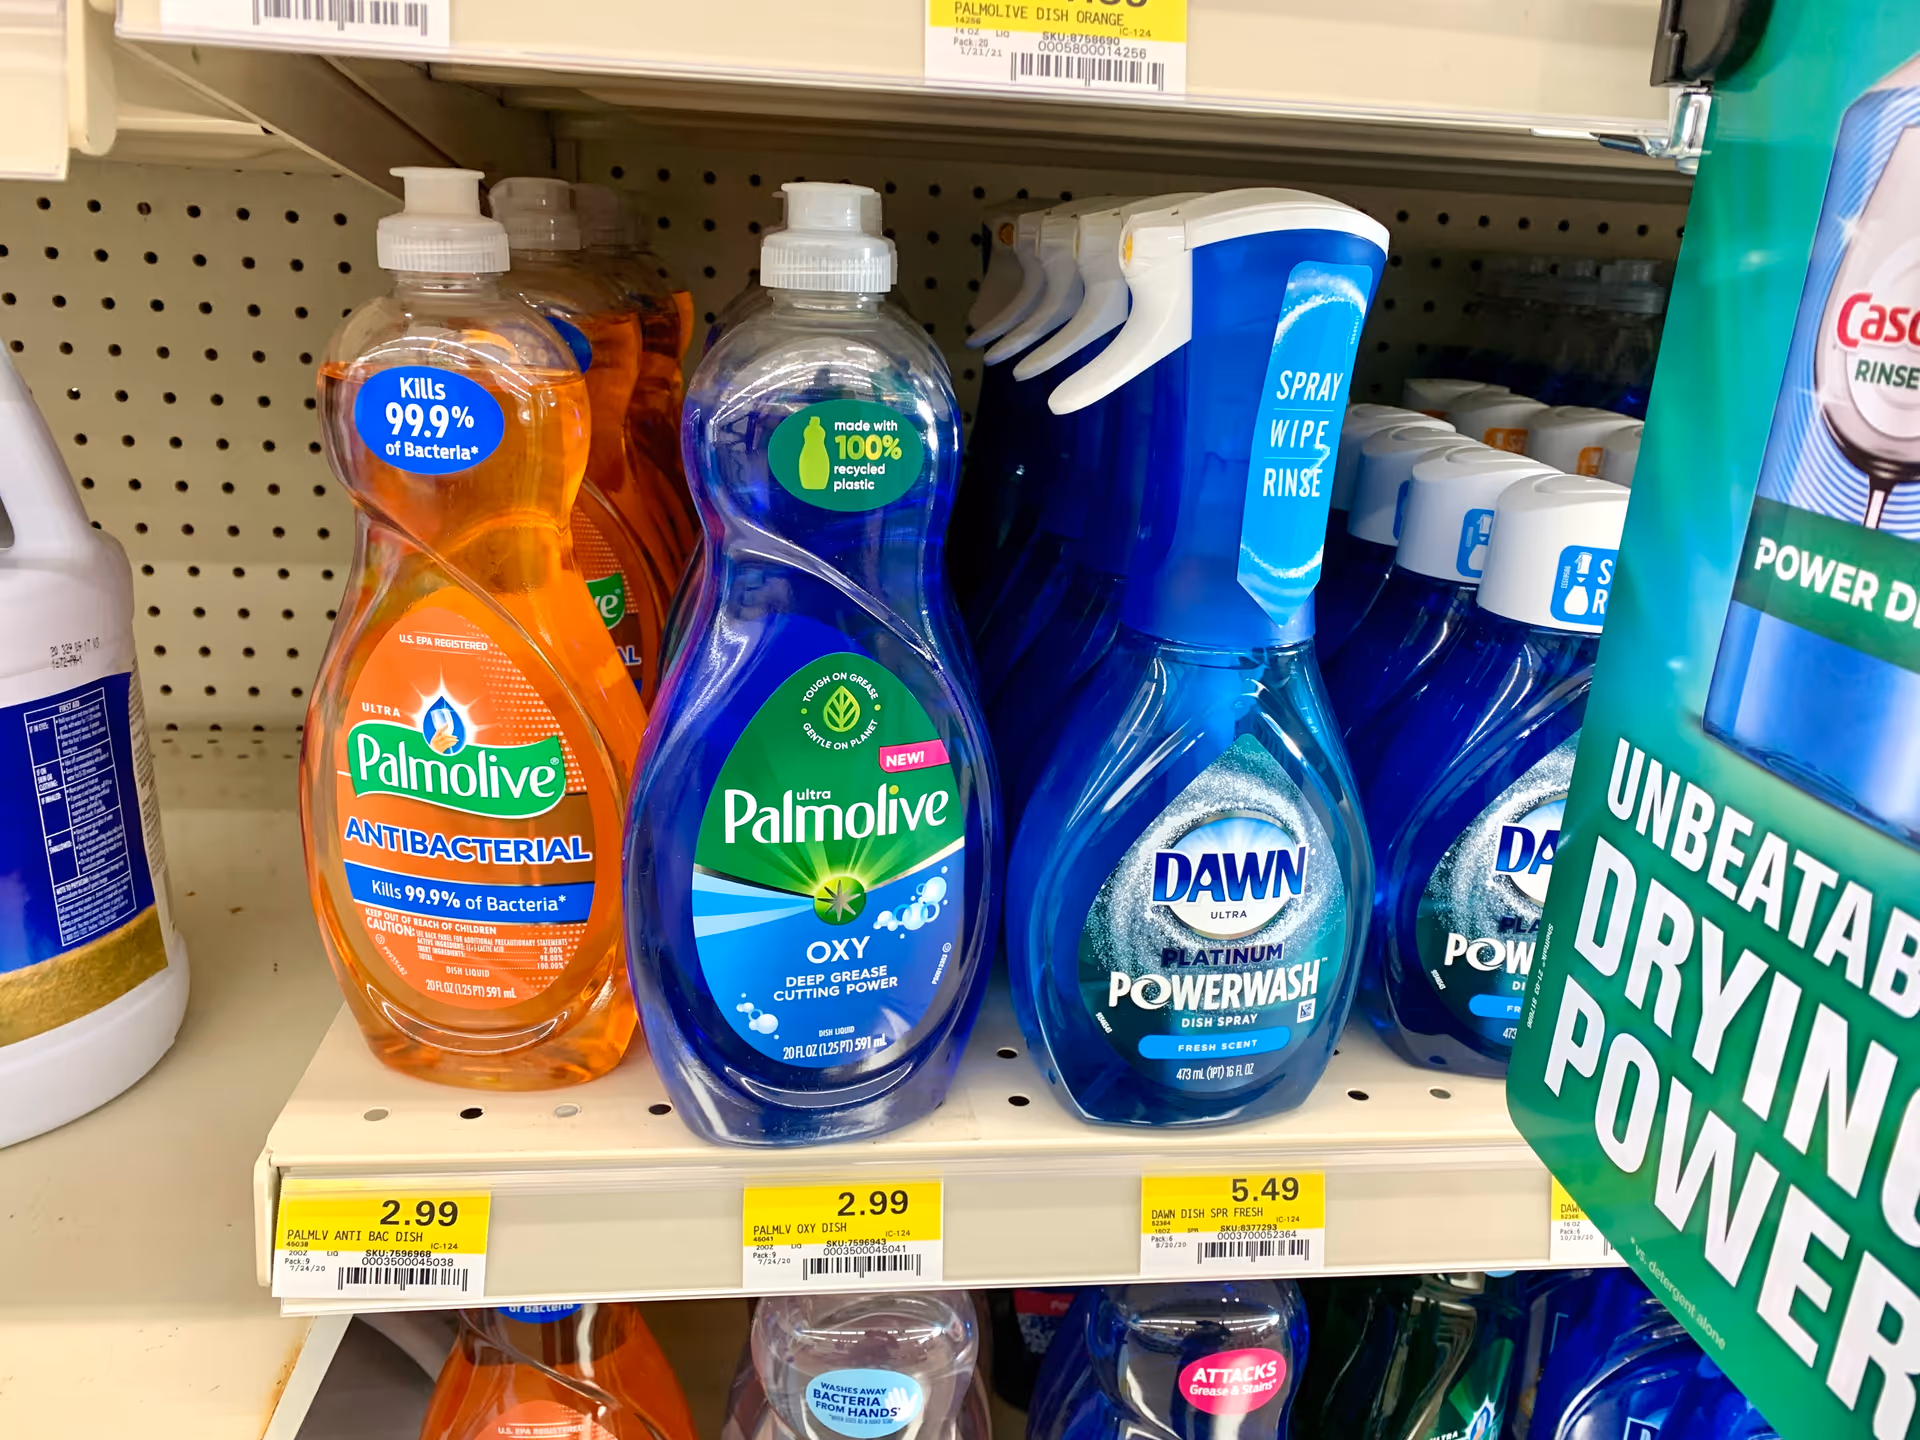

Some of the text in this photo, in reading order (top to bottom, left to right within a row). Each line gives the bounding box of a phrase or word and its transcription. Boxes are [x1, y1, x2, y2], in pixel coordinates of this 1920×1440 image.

[954, 1, 1124, 26] PALMOLIVE DISH ORANGE
[954, 36, 988, 48] Pack:20
[1119, 28, 1152, 38] IC-124
[1038, 40, 1147, 60] 0005800014256
[1854, 358, 1920, 390] RINSE
[400, 376, 446, 400] Kills
[1276, 370, 1344, 401] SPRAY
[385, 402, 474, 438] 99.9%
[834, 420, 898, 432] made with
[1270, 420, 1329, 448] WIPE
[386, 440, 401, 456] of
[834, 434, 902, 460] 100%
[834, 463, 886, 477] recycled
[834, 478, 874, 492] plastic
[1262, 468, 1323, 498] RINSE
[1754, 536, 1879, 612] POWER
[399, 634, 488, 651] U.S. EPA REGISTERED
[802, 672, 878, 702] TOUGH ON GREASE
[362, 702, 400, 718] ULTRA
[802, 718, 878, 750] GENTLE ON PLANET
[357, 733, 556, 798] Palmolive
[886, 750, 924, 768] NEW!
[796, 788, 831, 800] ultra
[724, 783, 949, 844] Palmolive
[344, 816, 592, 864] ANTIBACTERIAL
[1152, 846, 1307, 902] DAWN
[372, 879, 402, 900] Kills
[404, 884, 461, 908] 99.9%
[466, 896, 482, 910] of
[365, 907, 496, 934] KEEP OUT OF REACH OF CHILDREN
[1210, 910, 1247, 920] ULTRA
[366, 916, 415, 937] CAUTION:
[537, 938, 567, 946] STATEMENTS
[806, 936, 870, 964] OXY
[1160, 944, 1284, 968] PLATINUM
[446, 966, 490, 977] DISH LIQUID
[786, 965, 887, 988] DEEP GREASE
[426, 979, 435, 991] 20
[486, 986, 501, 998] 591
[504, 987, 517, 999] mL
[774, 976, 898, 1002] CUTTING POWER
[1108, 961, 1320, 1011] POWERWASH
[1534, 969, 1544, 995] 21-03
[1182, 1014, 1258, 1028] DISH SPRAY
[819, 1026, 855, 1037] DISH LIQUID
[1503, 1028, 1517, 1039] 473
[783, 1046, 796, 1060] 20
[839, 1039, 853, 1054] PT)
[855, 1037, 872, 1052] 591
[873, 1034, 887, 1048] mL
[1178, 1039, 1258, 1053] FRESH SCENT
[1177, 1062, 1254, 1080] 473 mL (1PT) 16 FL OZ
[1232, 1177, 1299, 1202] 5.49
[837, 1190, 909, 1216] 2.99
[1561, 1204, 1580, 1213] DAW
[380, 1200, 458, 1226] 2.99
[1152, 1207, 1263, 1220] DAWN DISH SPR FRESH
[287, 1230, 423, 1242] PALMLV ANTI BAC DISH
[753, 1222, 847, 1235] PALMLV OXY DISH
[1217, 1231, 1297, 1240] 0003700052364
[1220, 1224, 1277, 1232] SKU:8377293
[823, 1245, 906, 1256] 0003500045041
[826, 1239, 886, 1248] SKU:7596943
[284, 1258, 310, 1266] Pack:9
[362, 1257, 454, 1267] 0003500045038
[366, 1250, 432, 1258] SKU:7596968
[1648, 1261, 1696, 1318] detergent
[1697, 1314, 1726, 1350] alone
[1192, 1361, 1277, 1383] ATTACKS
[813, 1388, 881, 1407] BACTERIA
[821, 1382, 858, 1394] WASHES
[1190, 1384, 1228, 1396] Grease
[1230, 1386, 1238, 1395] &
[816, 1401, 844, 1413] FROM
